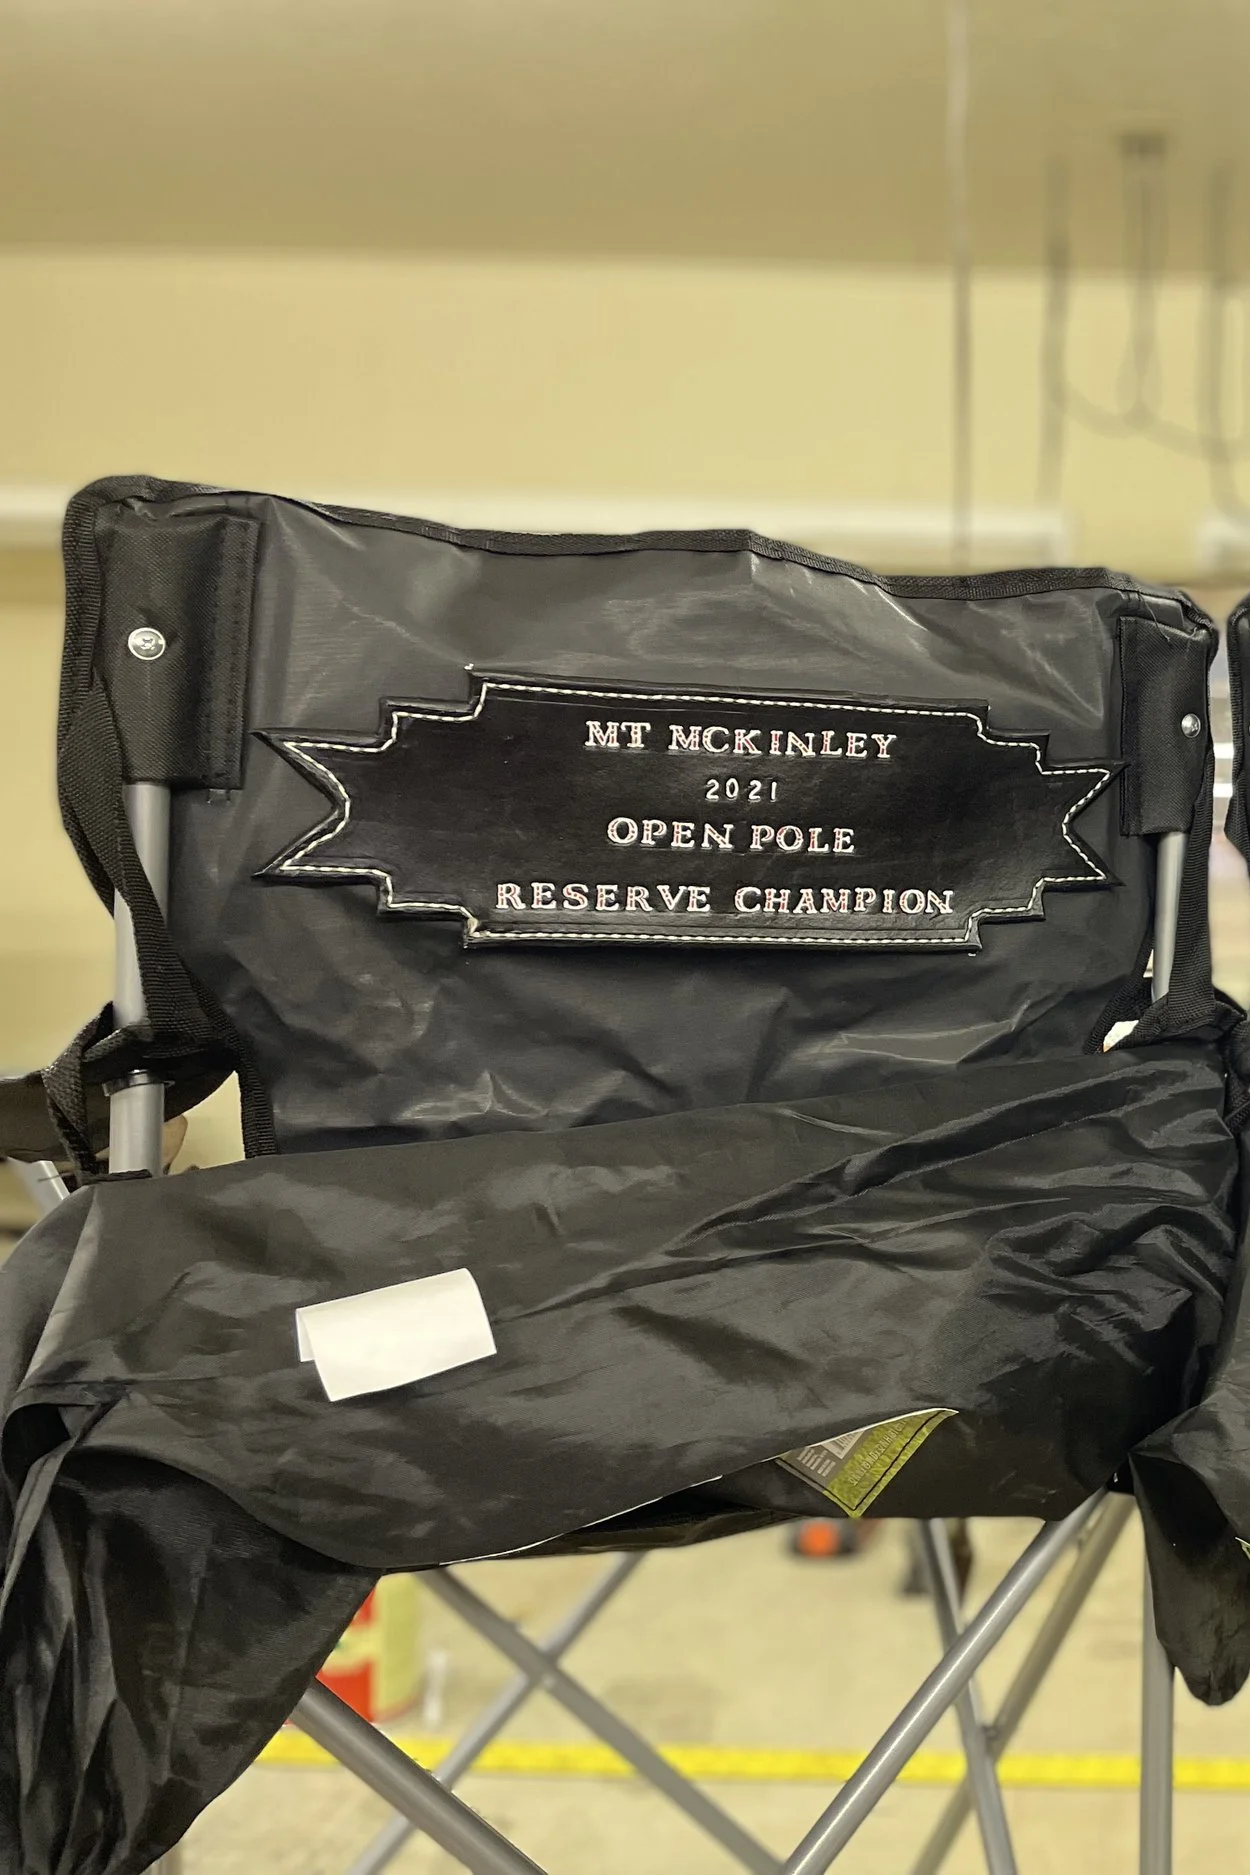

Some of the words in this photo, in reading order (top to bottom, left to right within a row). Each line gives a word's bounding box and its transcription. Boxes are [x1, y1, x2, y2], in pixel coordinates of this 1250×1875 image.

[585, 720, 651, 749] MT
[668, 724, 898, 759] MCKINLEY
[705, 777, 778, 800] 2021
[607, 816, 733, 849] OPEN
[749, 824, 856, 854] POLE
[495, 881, 711, 913] RESERVE
[735, 885, 954, 915] CHAMPION
